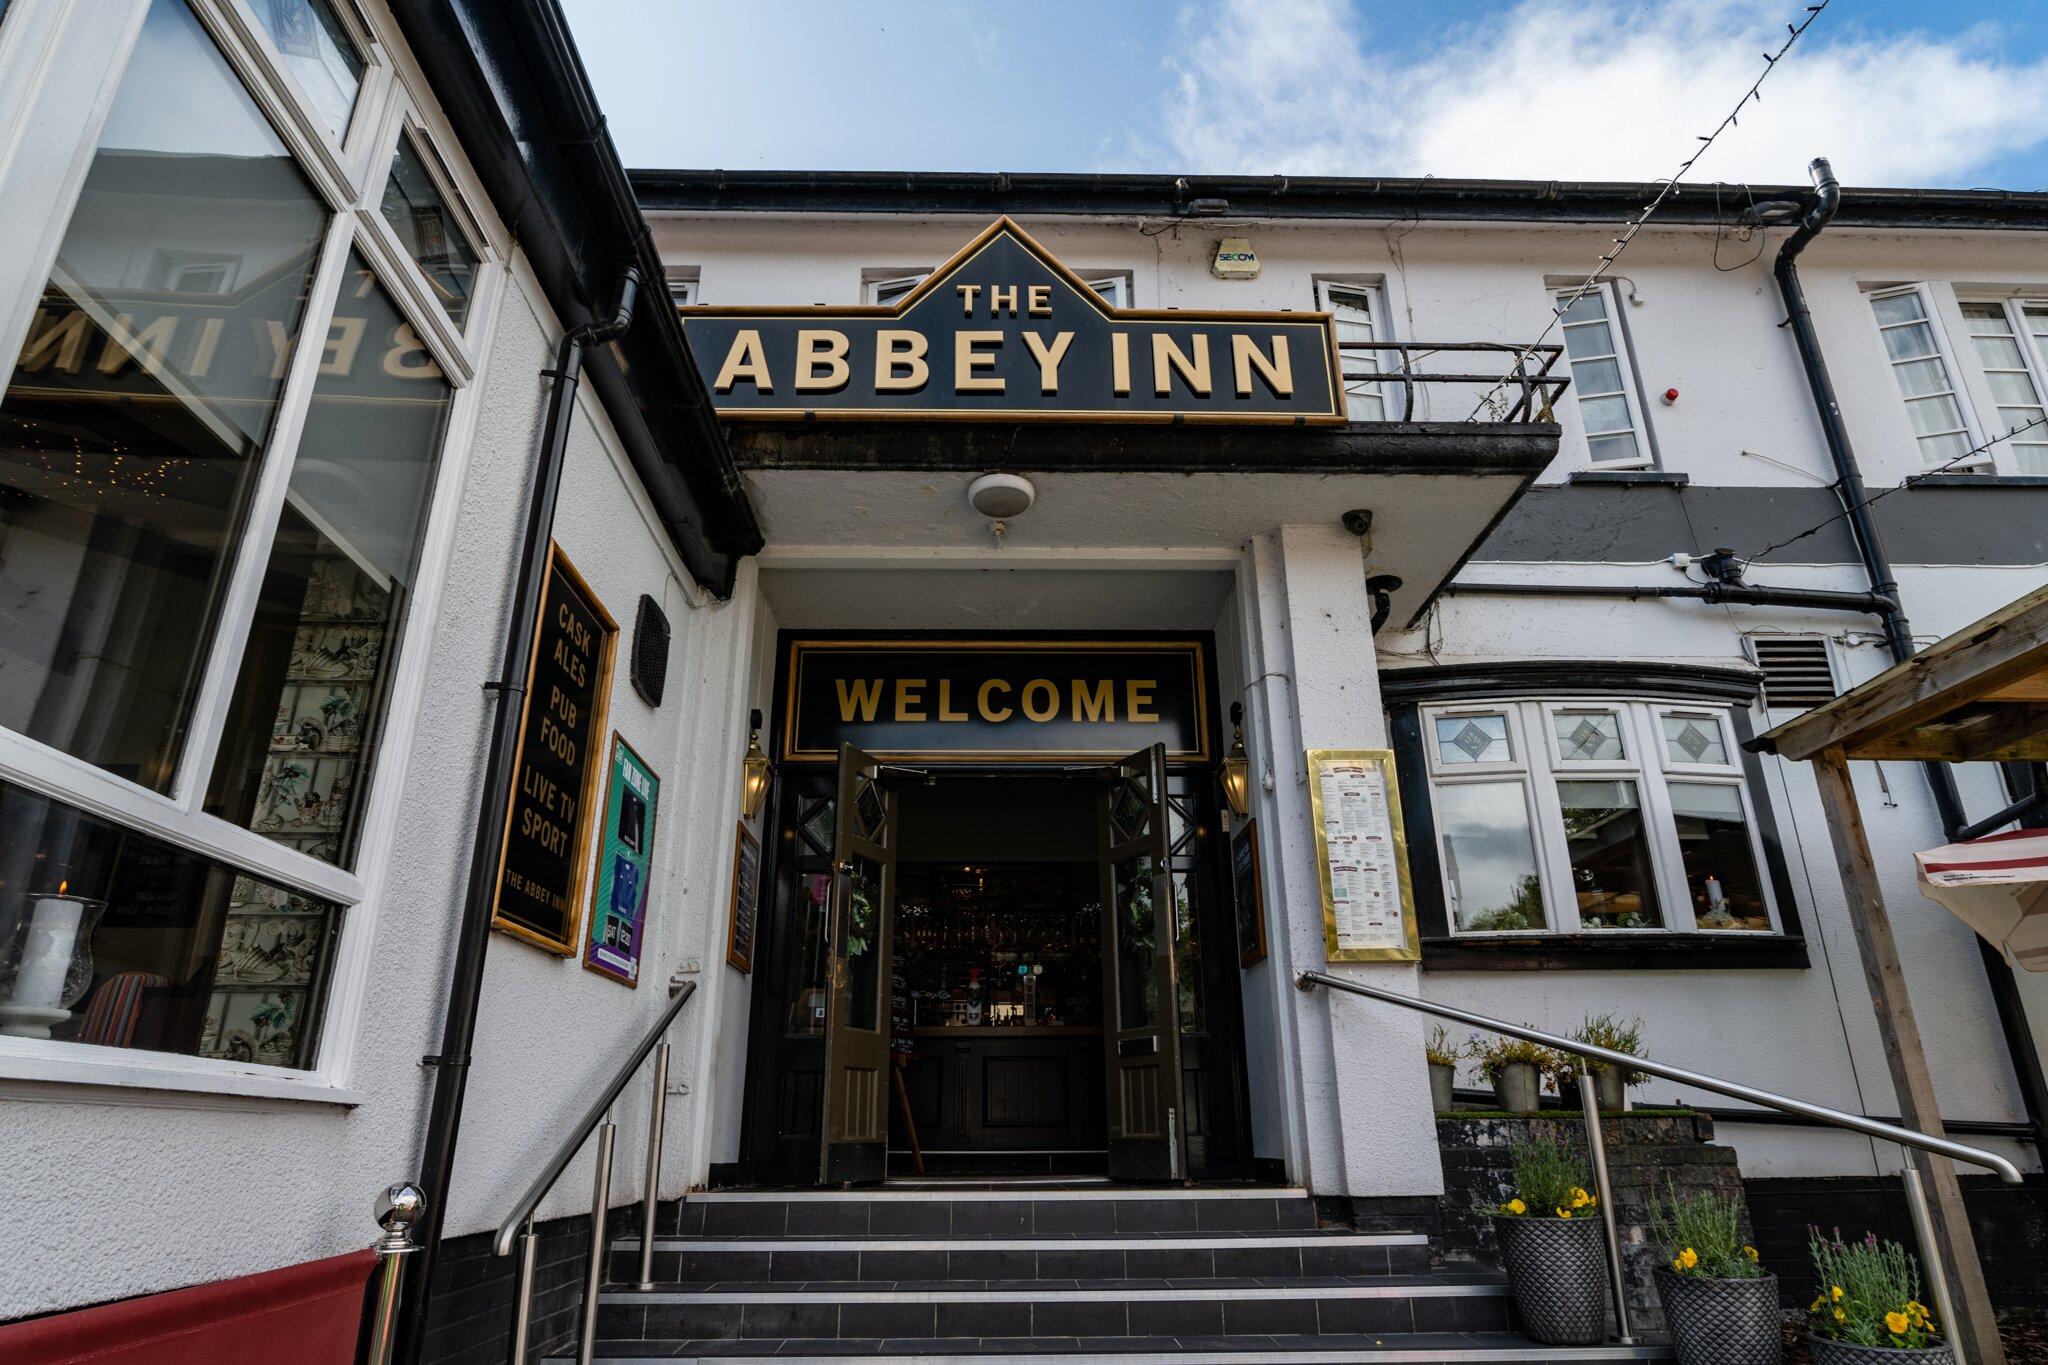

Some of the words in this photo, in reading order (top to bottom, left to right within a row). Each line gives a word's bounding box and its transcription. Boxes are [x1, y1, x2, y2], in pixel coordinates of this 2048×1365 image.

[1219, 253, 1254, 261] SECOM
[956, 284, 1053, 316] THE
[713, 329, 1076, 392] ABBEY
[1111, 332, 1295, 395] INN
[558, 603, 591, 657] CASK
[554, 638, 586, 688] ALES
[550, 684, 577, 729] PUB
[835, 678, 1160, 722] WELCOME
[540, 716, 576, 766] FOOD
[523, 764, 557, 811] LIVE
[560, 791, 576, 824] TV
[522, 807, 568, 858] SPORT
[505, 868, 523, 891] THE
[524, 879, 551, 905] ABBEY
[552, 893, 566, 913] INN
